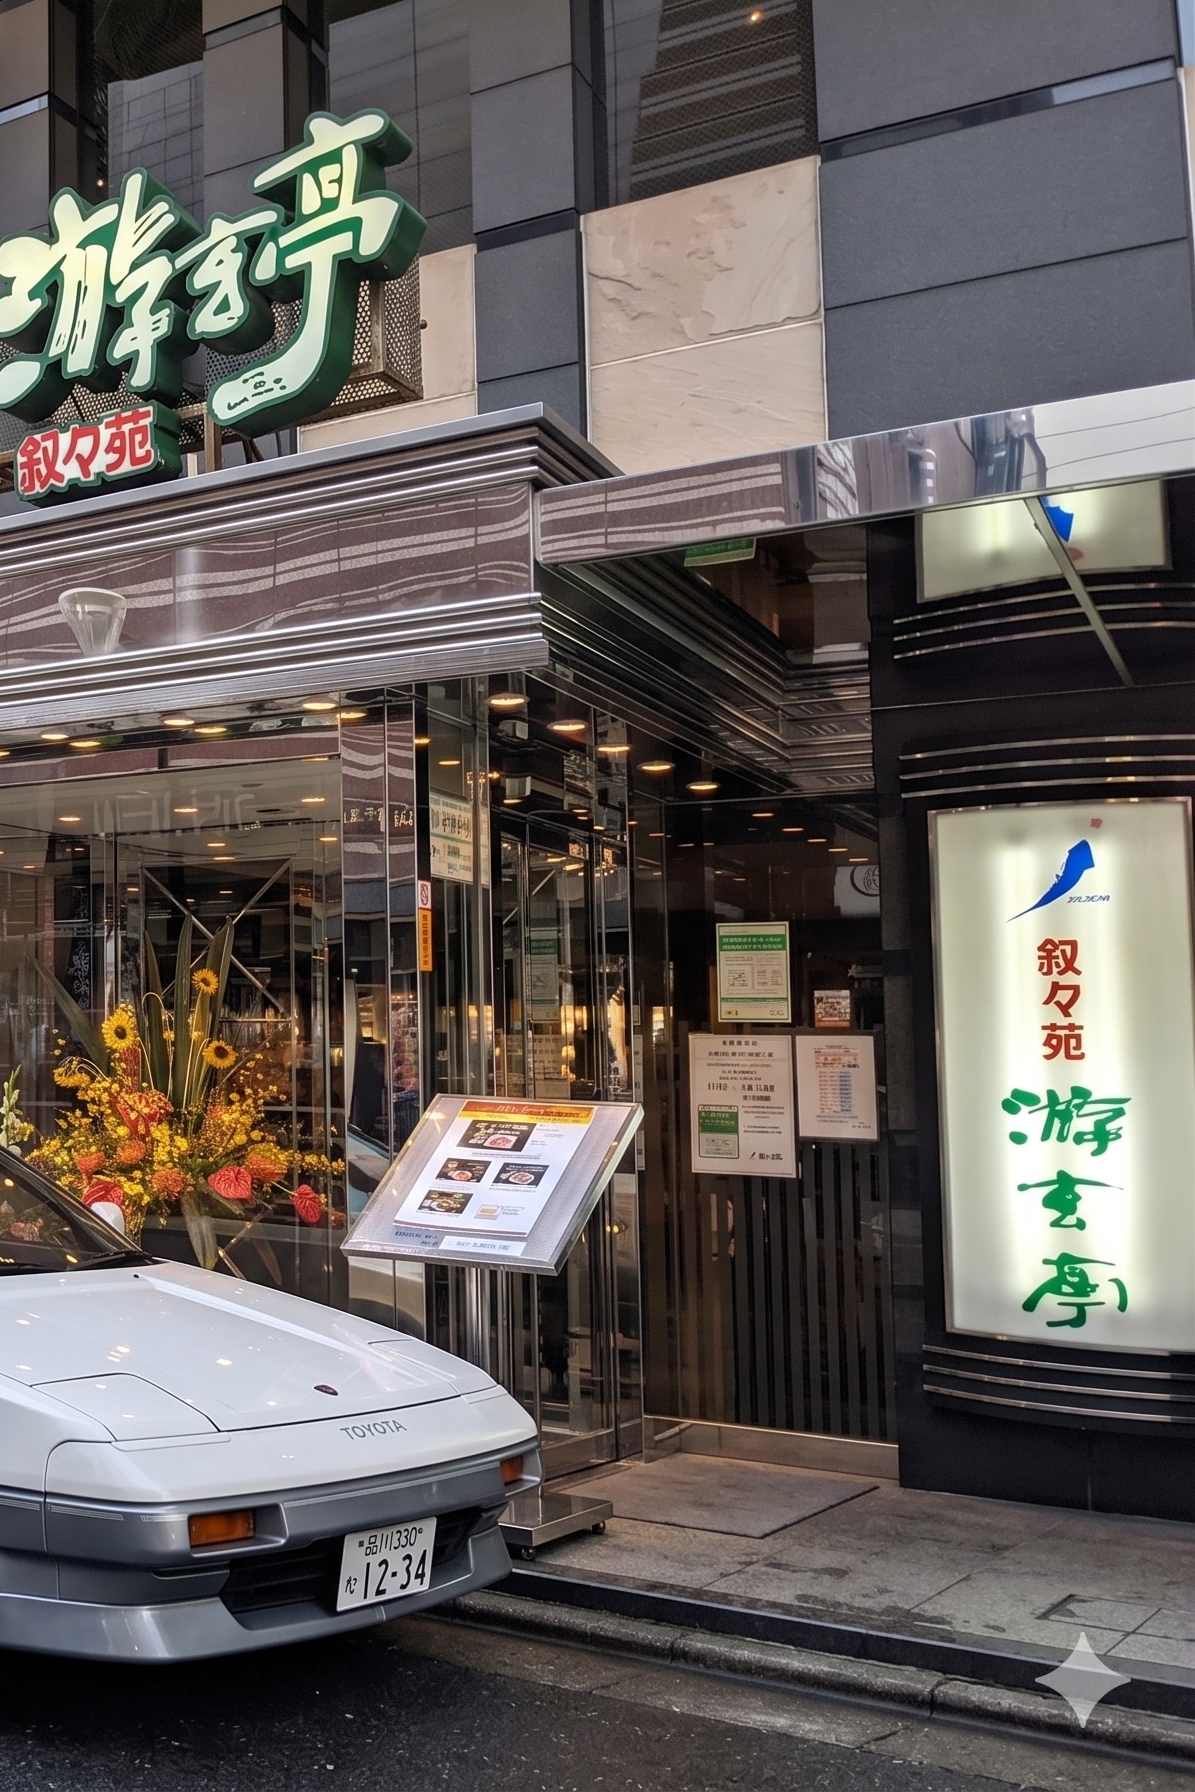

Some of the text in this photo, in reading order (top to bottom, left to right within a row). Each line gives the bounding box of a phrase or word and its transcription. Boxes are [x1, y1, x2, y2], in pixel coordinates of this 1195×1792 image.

[16, 403, 156, 500] 叙々苑
[1037, 938, 1085, 1060] 叙々苑
[340, 1419, 407, 1440] TOYOTA
[363, 1549, 428, 1600] 12-34
